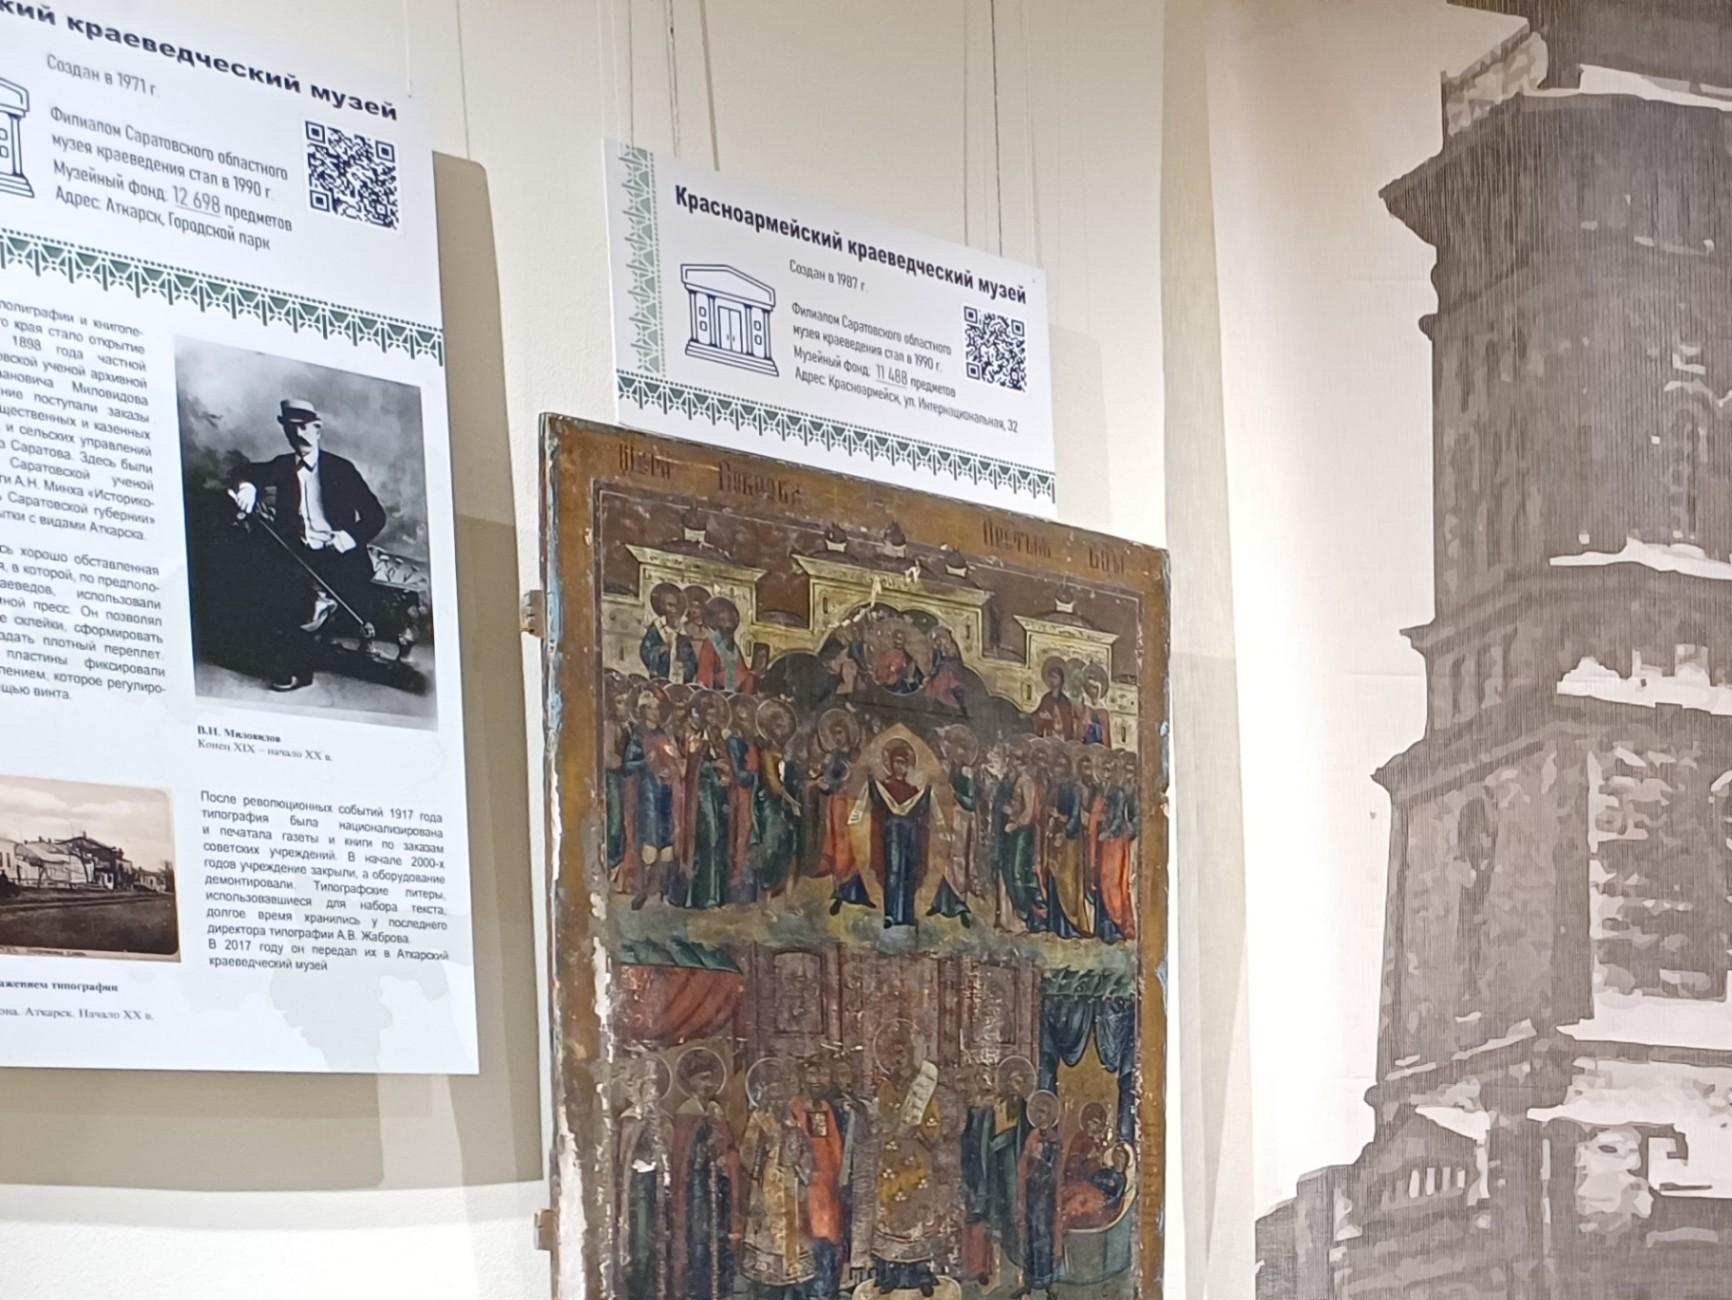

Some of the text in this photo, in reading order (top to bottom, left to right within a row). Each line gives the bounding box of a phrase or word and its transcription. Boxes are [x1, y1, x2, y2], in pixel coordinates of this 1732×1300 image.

[46, 53, 100, 81] Создан
[116, 71, 146, 93] 1971
[66, 15, 300, 91] краеведческий
[310, 83, 396, 116] музей
[50, 105, 288, 181] Филиалом Саратовского областного
[51, 133, 93, 154] музея
[95, 145, 185, 177] краеведения
[188, 167, 218, 186] стал
[231, 174, 262, 197] 1990
[53, 158, 125, 190] Музейный
[192, 191, 221, 213] 698
[223, 203, 293, 232] предметов
[105, 196, 165, 226] Аткарск,
[167, 210, 236, 241] Городской
[238, 231, 271, 250] парк
[674, 184, 1026, 304] Красноармейский краеведческий музей
[788, 258, 826, 281] Создан
[835, 271, 858, 289] 1987
[790, 301, 952, 356] Филиалом Саратовского областного
[11, 334, 147, 372] 1898 года частной
[792, 324, 821, 340] музея
[821, 332, 883, 356] краеведения
[883, 348, 905, 362] стал
[913, 352, 934, 370] 1990
[792, 344, 842, 368] Музейный
[887, 367, 908, 386] 488
[909, 376, 956, 398] предметов
[827, 374, 902, 405] Красноармейск,
[902, 395, 916, 409] ул.
[917, 396, 1006, 431] Интернациональная,
[78, 450, 117, 468] Здесь
[119, 457, 153, 474] были
[6, 490, 89, 514] Саратовской
[199, 789, 443, 824] После революционных событий 1917 года
[200, 808, 444, 839] типография была национализирована
[202, 841, 260, 855] советских
[364, 854, 402, 866] начале
[410, 855, 445, 869] 2000-х
[203, 857, 237, 870] годов
[239, 861, 307, 875] учреждение
[371, 868, 446, 884] оборудование
[205, 891, 312, 906] использовавшиеся
[325, 898, 347, 909] для
[359, 899, 399, 914] набора
[312, 879, 389, 897] Типографские
[205, 907, 246, 919] долгое
[257, 910, 293, 922] время
[303, 913, 361, 925] хранились
[387, 918, 448, 930] последнего
[206, 923, 267, 938] директора
[268, 926, 335, 940] типографии
[208, 956, 328, 973] краеведческий музей
[224, 938, 252, 951] 2017
[258, 942, 284, 956] году
[311, 945, 358, 957] передал
[396, 947, 449, 961] Аткарский
